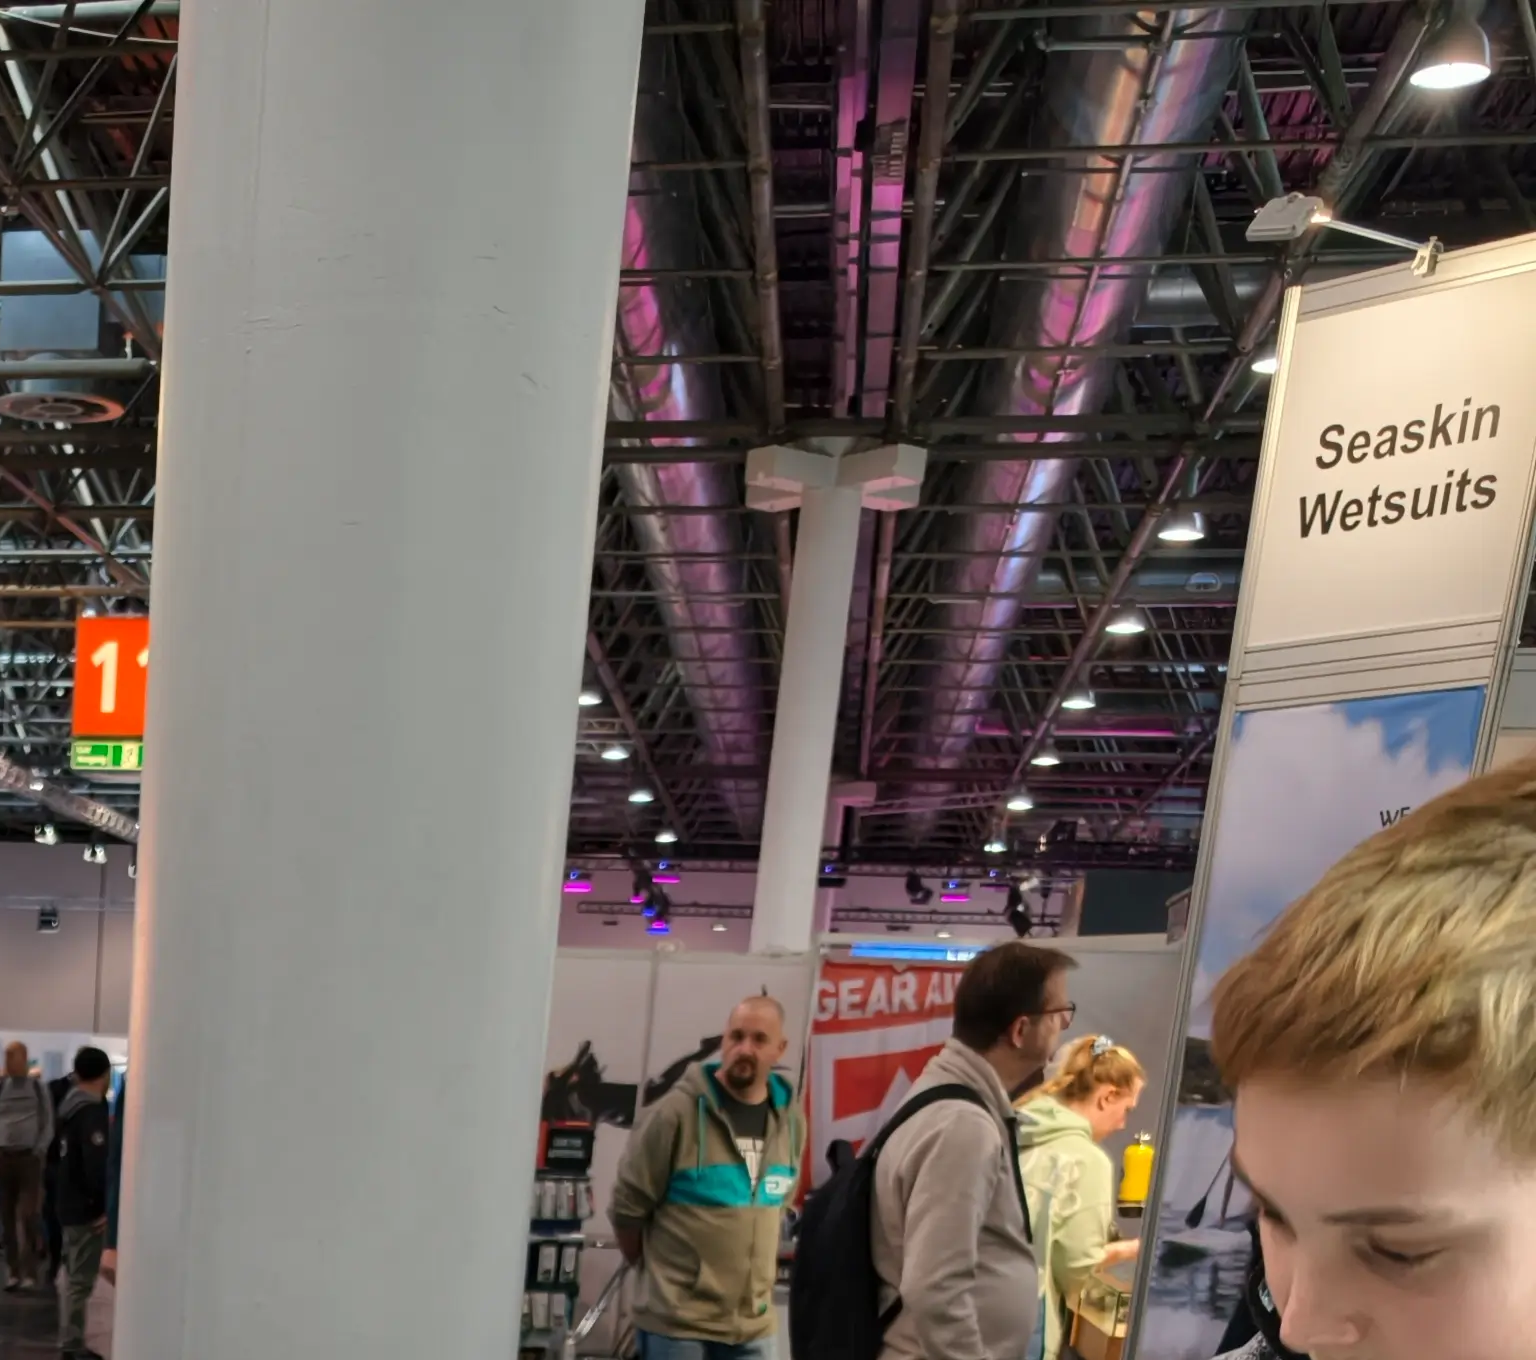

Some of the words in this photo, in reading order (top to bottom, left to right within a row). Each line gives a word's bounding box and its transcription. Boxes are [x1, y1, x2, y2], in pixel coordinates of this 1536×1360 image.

[1315, 397, 1501, 470] Seaskin
[1299, 468, 1498, 539] Wetsuits
[812, 971, 918, 1022] GEAR
